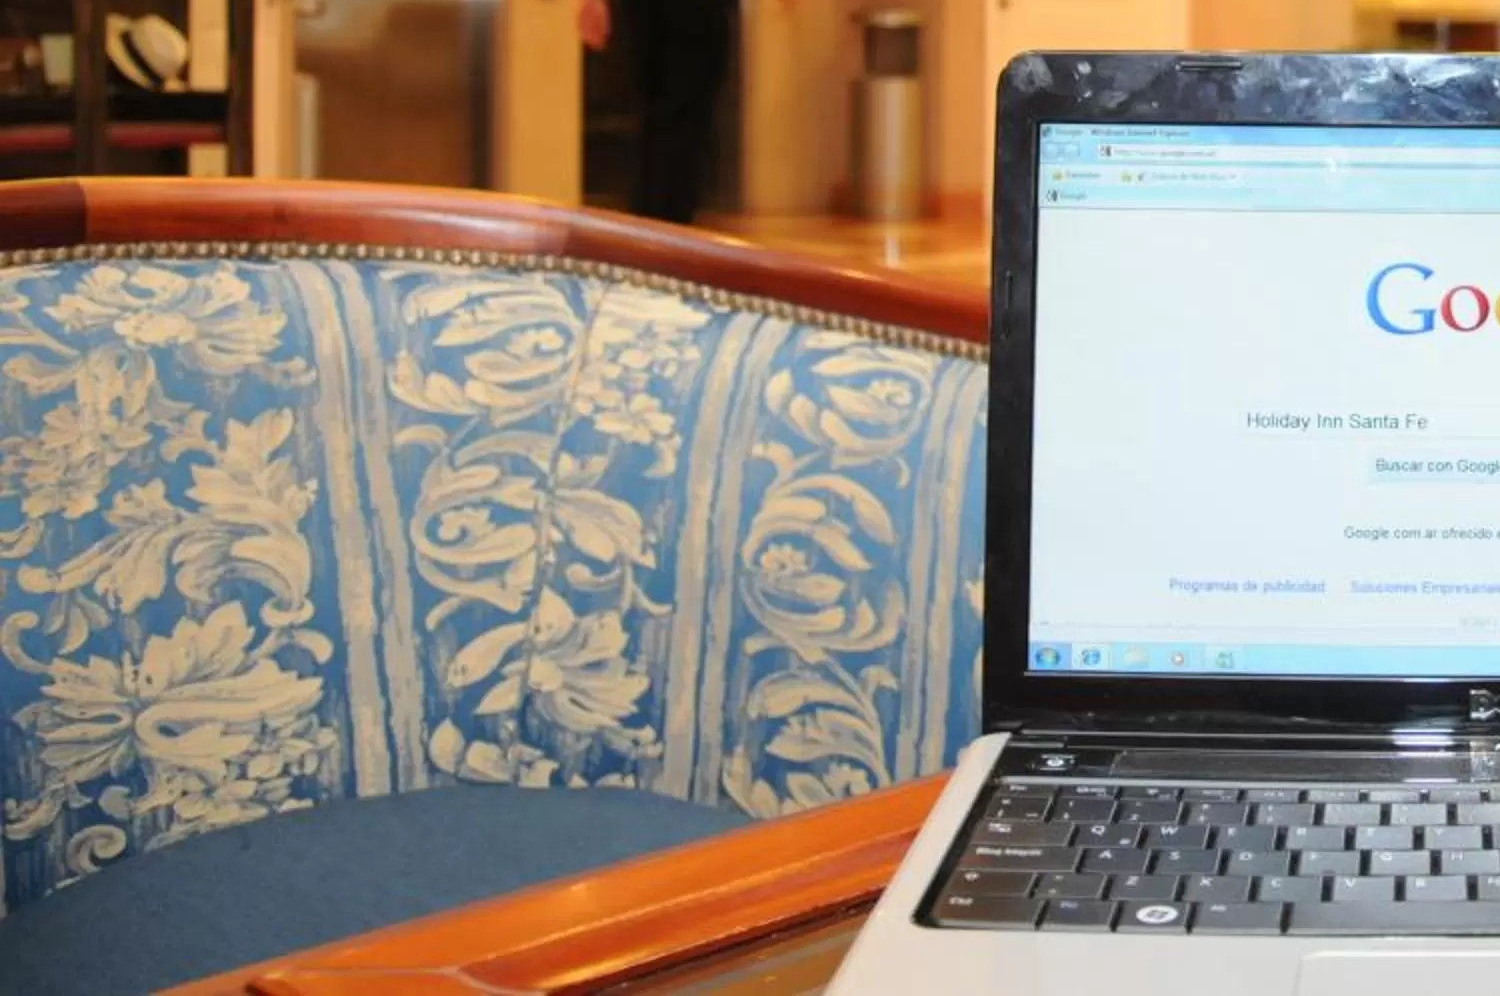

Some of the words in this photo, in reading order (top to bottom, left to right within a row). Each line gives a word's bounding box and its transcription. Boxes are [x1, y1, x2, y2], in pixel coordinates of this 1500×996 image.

[1247, 411, 1310, 432] Holiday
[1317, 412, 1343, 429] Inn
[1349, 413, 1399, 429] Santa
[1405, 413, 1428, 429] Fe
[1375, 458, 1423, 472] Buscar
[1427, 461, 1453, 472] con
